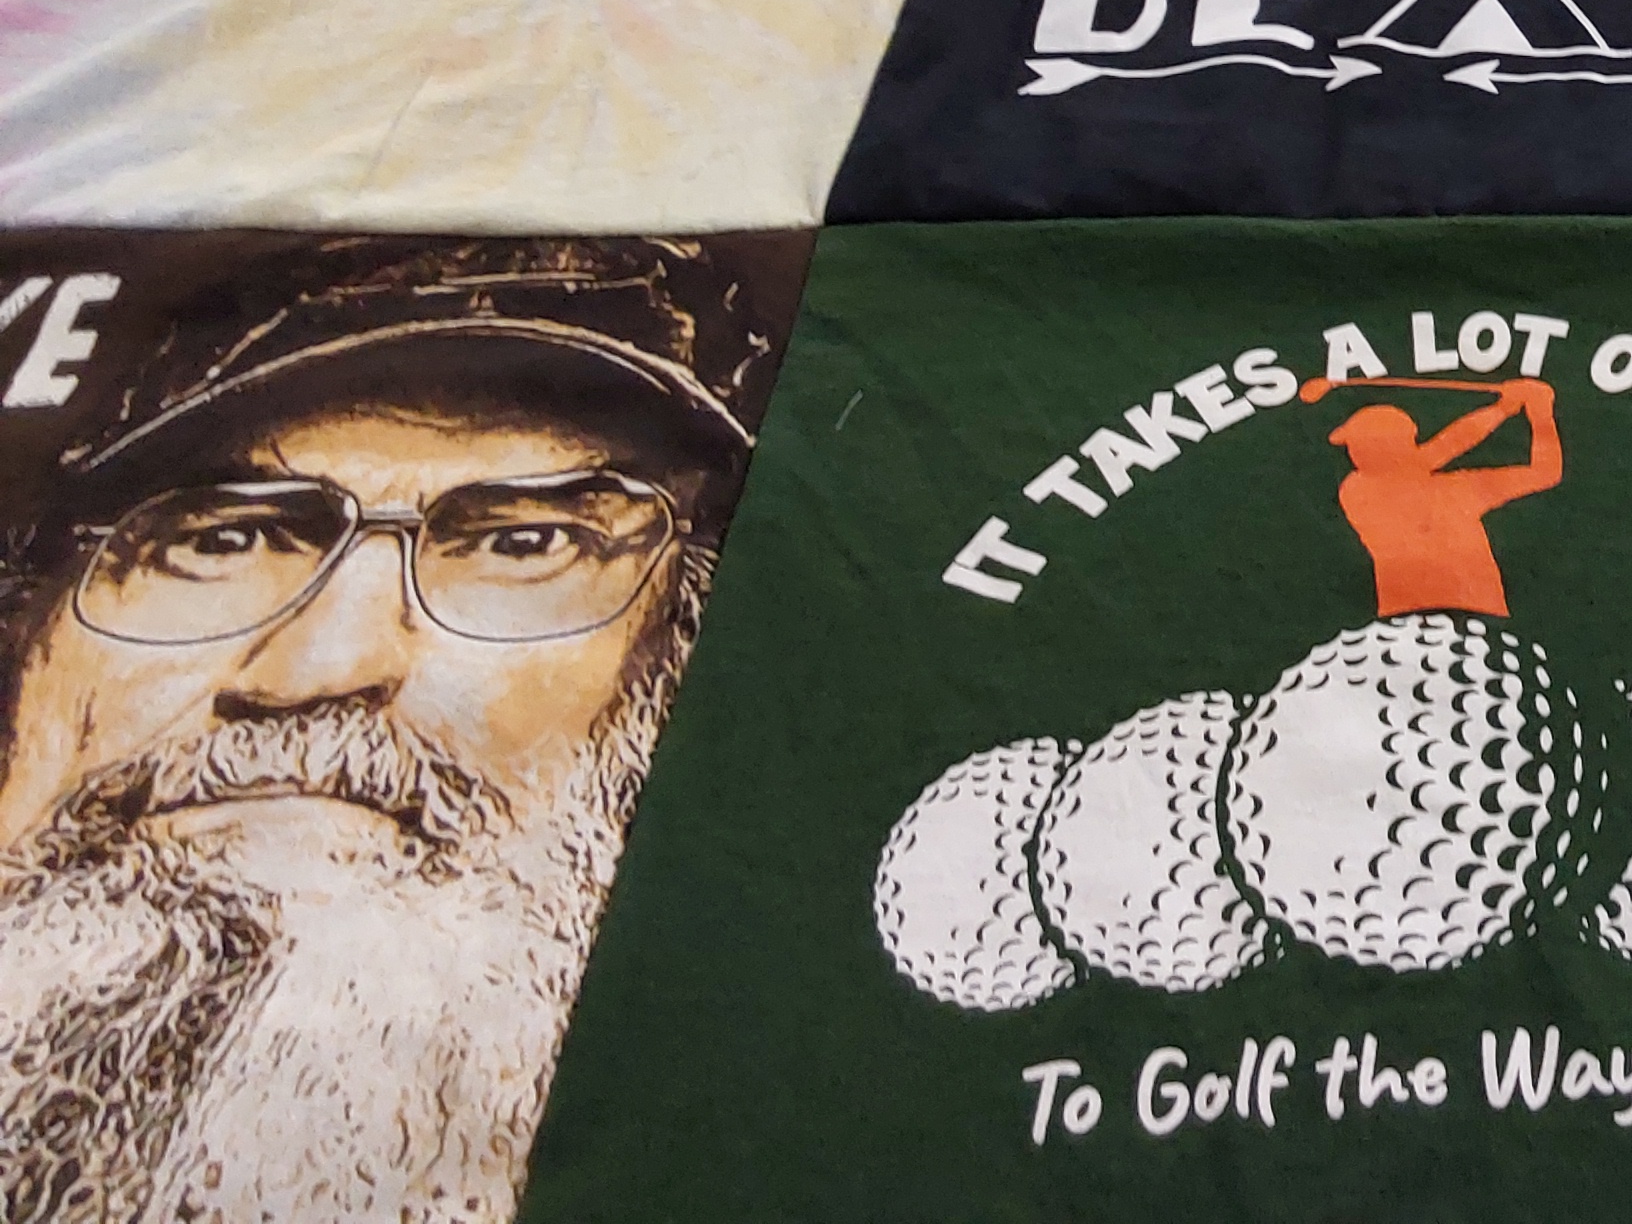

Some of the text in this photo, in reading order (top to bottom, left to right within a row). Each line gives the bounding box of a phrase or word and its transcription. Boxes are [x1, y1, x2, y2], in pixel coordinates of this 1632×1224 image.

[942, 516, 1047, 604] IT
[1023, 348, 1299, 518] TAKES
[1323, 322, 1388, 384] A
[1411, 310, 1570, 377] LOT
[1022, 1059, 1103, 1146] To
[1136, 1035, 1296, 1137] Golf
[1315, 1032, 1448, 1120] the
